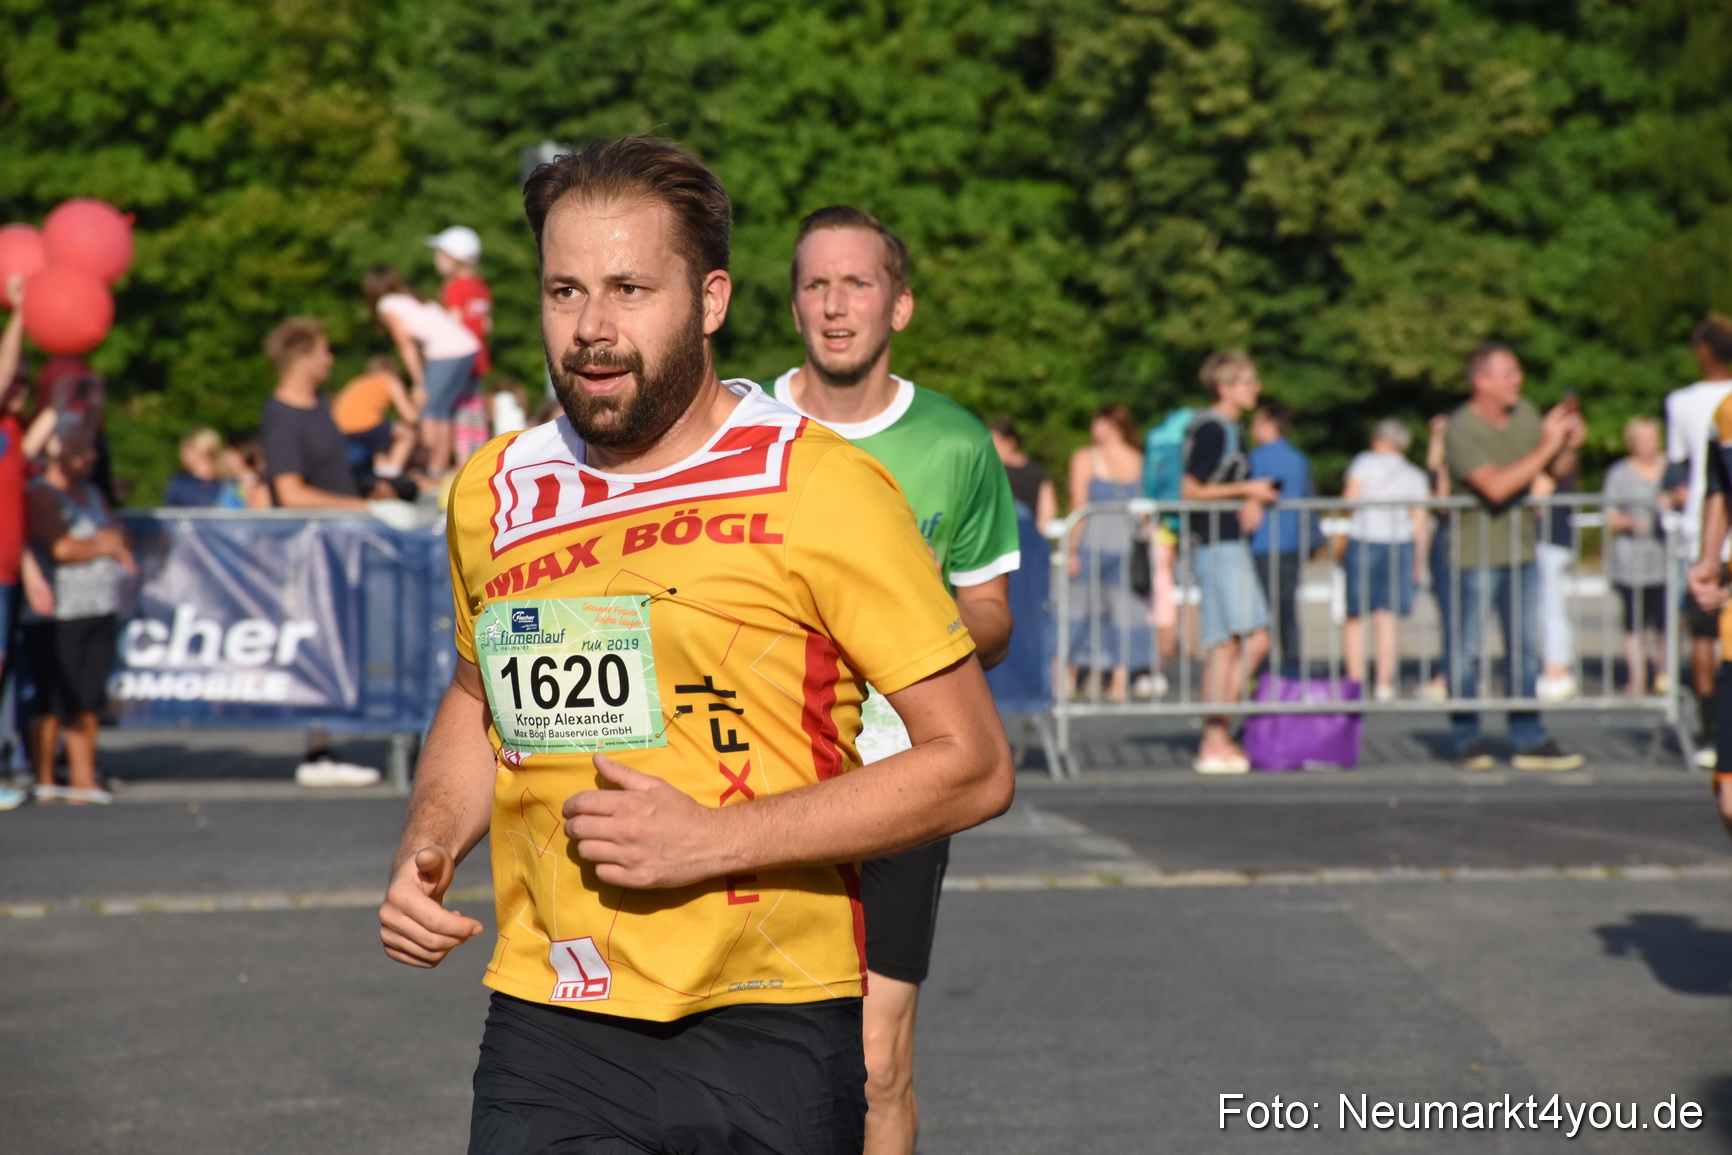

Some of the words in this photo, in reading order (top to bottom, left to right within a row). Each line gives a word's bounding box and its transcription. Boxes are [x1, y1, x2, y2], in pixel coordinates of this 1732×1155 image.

[484, 535, 603, 599] MAX
[621, 508, 784, 556] BÖGL
[120, 604, 317, 668] cher
[501, 629, 566, 645] firmenlauf
[581, 639, 602, 651] run
[607, 638, 639, 651] 2019
[501, 653, 630, 709] 1620
[515, 713, 550, 729] Kropp
[555, 712, 624, 726] Alexander
[514, 729, 528, 738] Max
[529, 730, 547, 741] Bögl
[548, 728, 599, 738] Bauservice
[601, 726, 632, 736] GmbH
